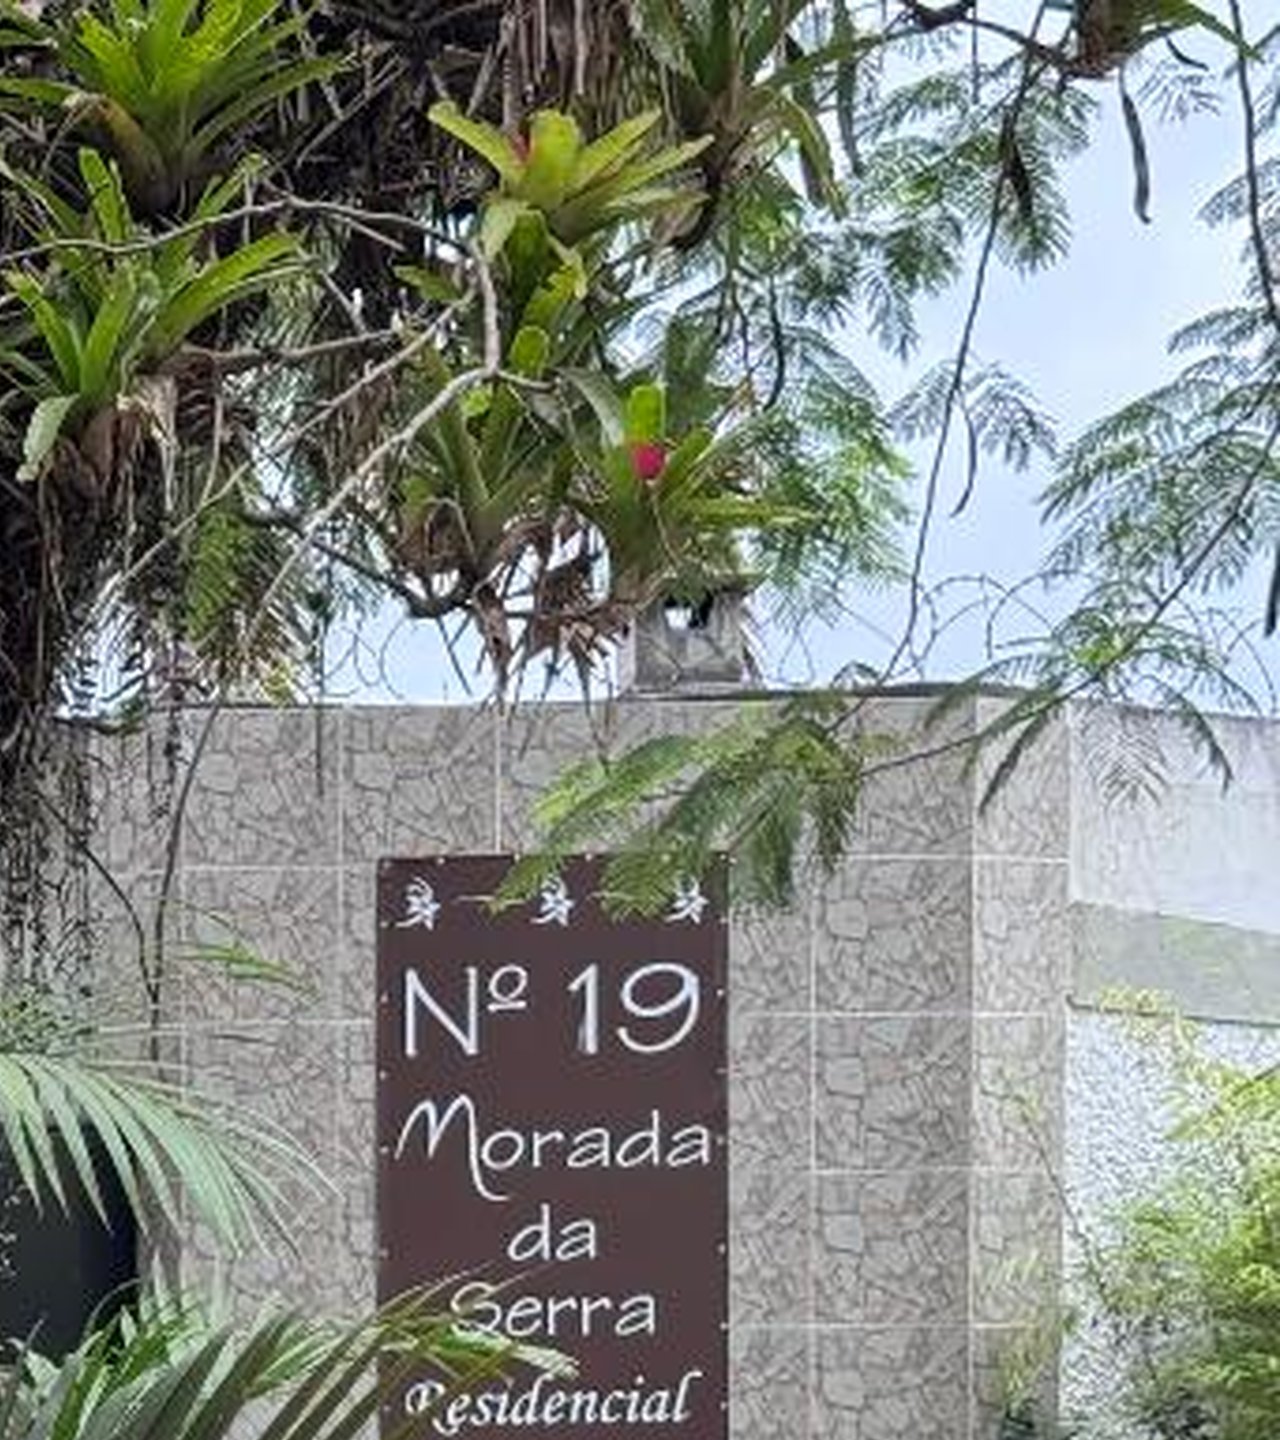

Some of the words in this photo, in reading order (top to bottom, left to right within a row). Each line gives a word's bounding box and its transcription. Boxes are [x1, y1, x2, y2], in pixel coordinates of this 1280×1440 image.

[568, 962, 702, 1054] 19
[394, 1094, 713, 1201] Morada
[508, 1203, 598, 1262] da
[449, 1282, 657, 1337] Serra
